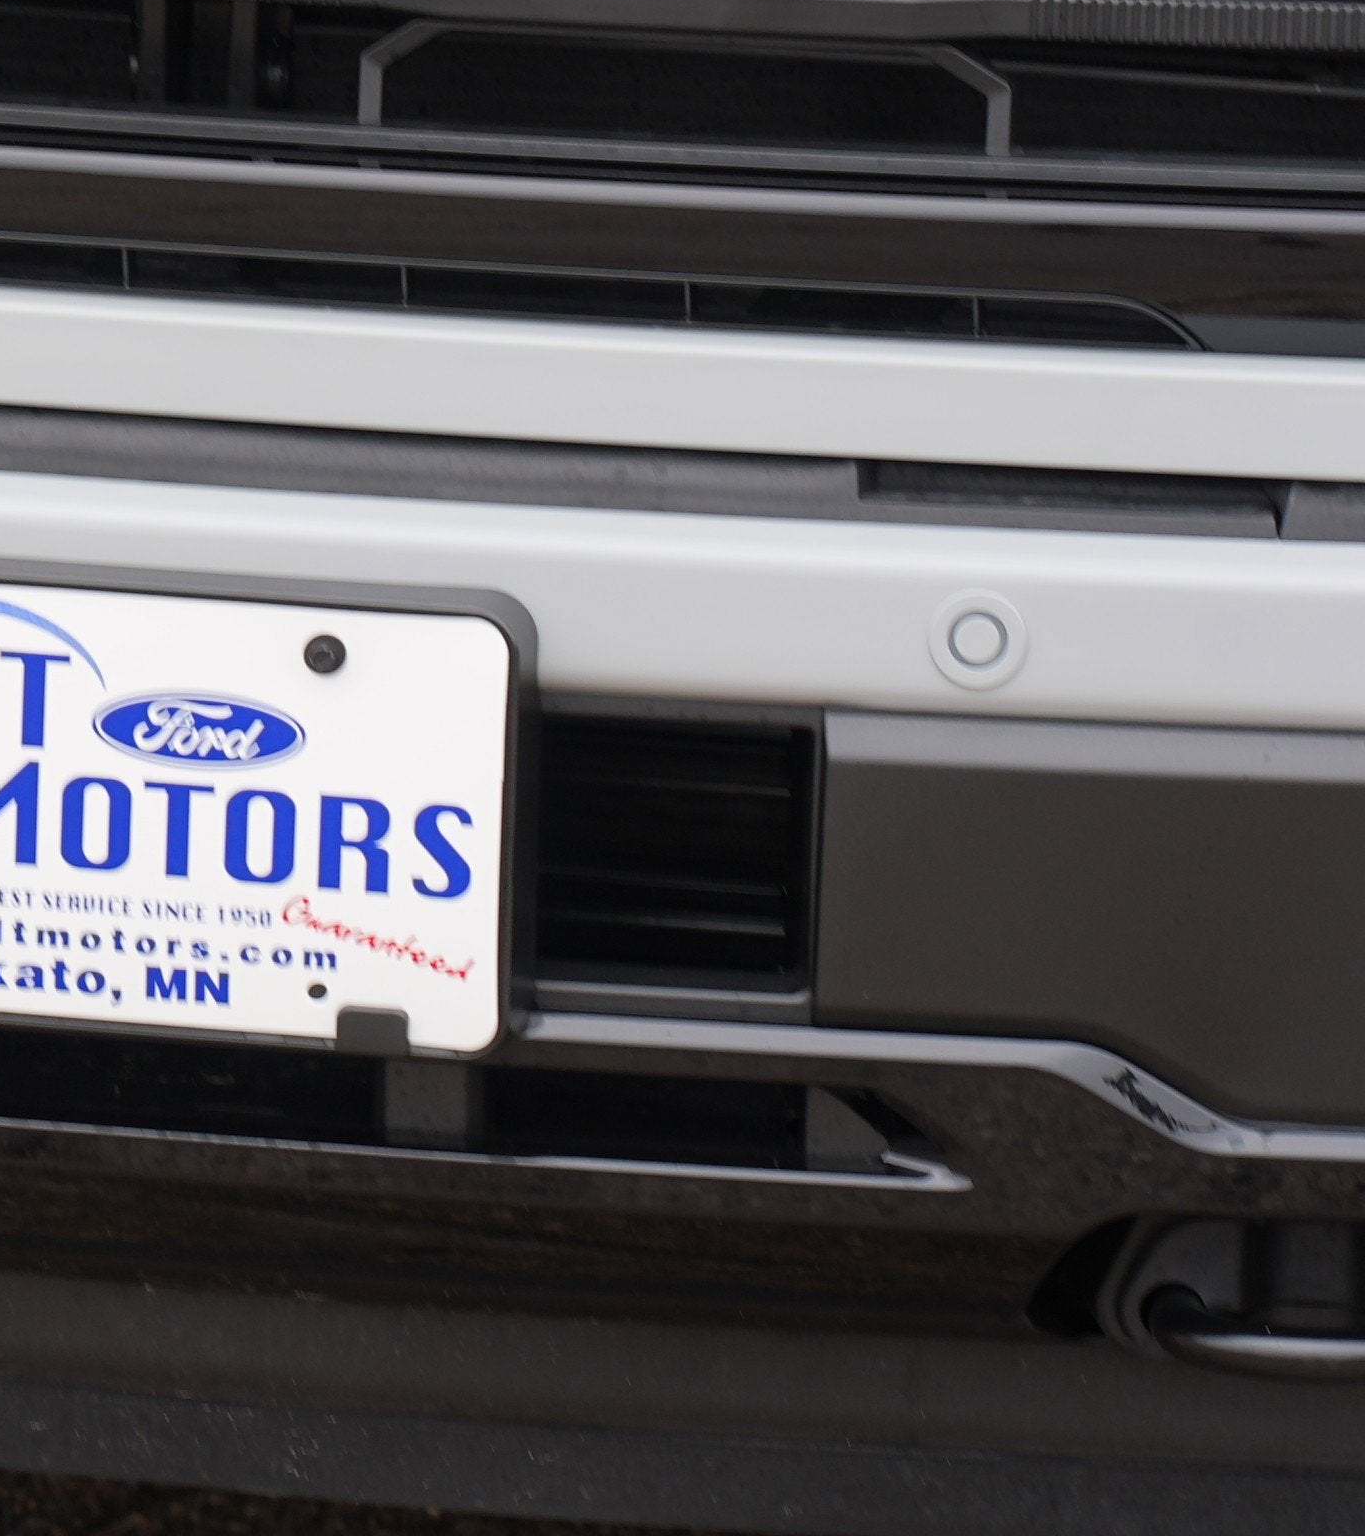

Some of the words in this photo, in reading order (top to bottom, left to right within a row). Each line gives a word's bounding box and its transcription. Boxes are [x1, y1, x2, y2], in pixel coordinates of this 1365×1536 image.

[132, 698, 265, 761] Ford
[43, 890, 132, 918] SERVICE
[142, 898, 207, 924] SINCE
[219, 904, 273, 929] 1950
[281, 894, 476, 981] Guaranteed
[145, 965, 230, 1005] MN
